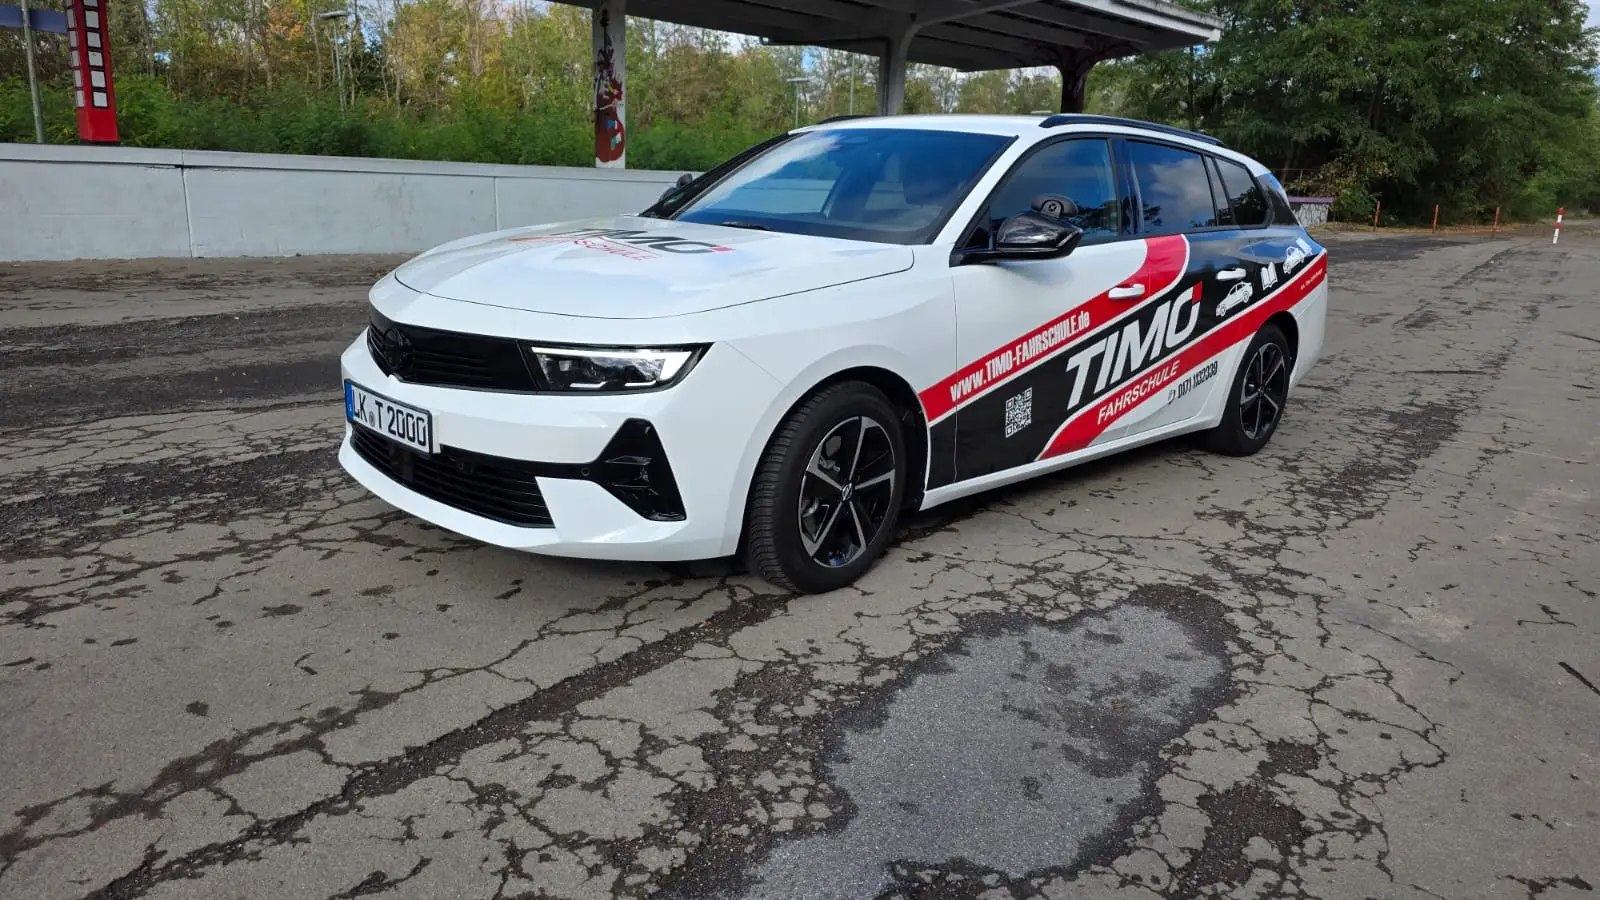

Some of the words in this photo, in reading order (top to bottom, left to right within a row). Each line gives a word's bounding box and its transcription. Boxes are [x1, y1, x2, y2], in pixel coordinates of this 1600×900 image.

[949, 310, 1090, 403] www.TIMO-FAHRSCHULE.de
[1065, 283, 1203, 411] TIMO
[352, 389, 368, 423] LK
[374, 399, 384, 431] T
[386, 405, 427, 447] 2000
[1097, 360, 1180, 425] FAHRSCHULE
[1177, 376, 1192, 399] 0171
